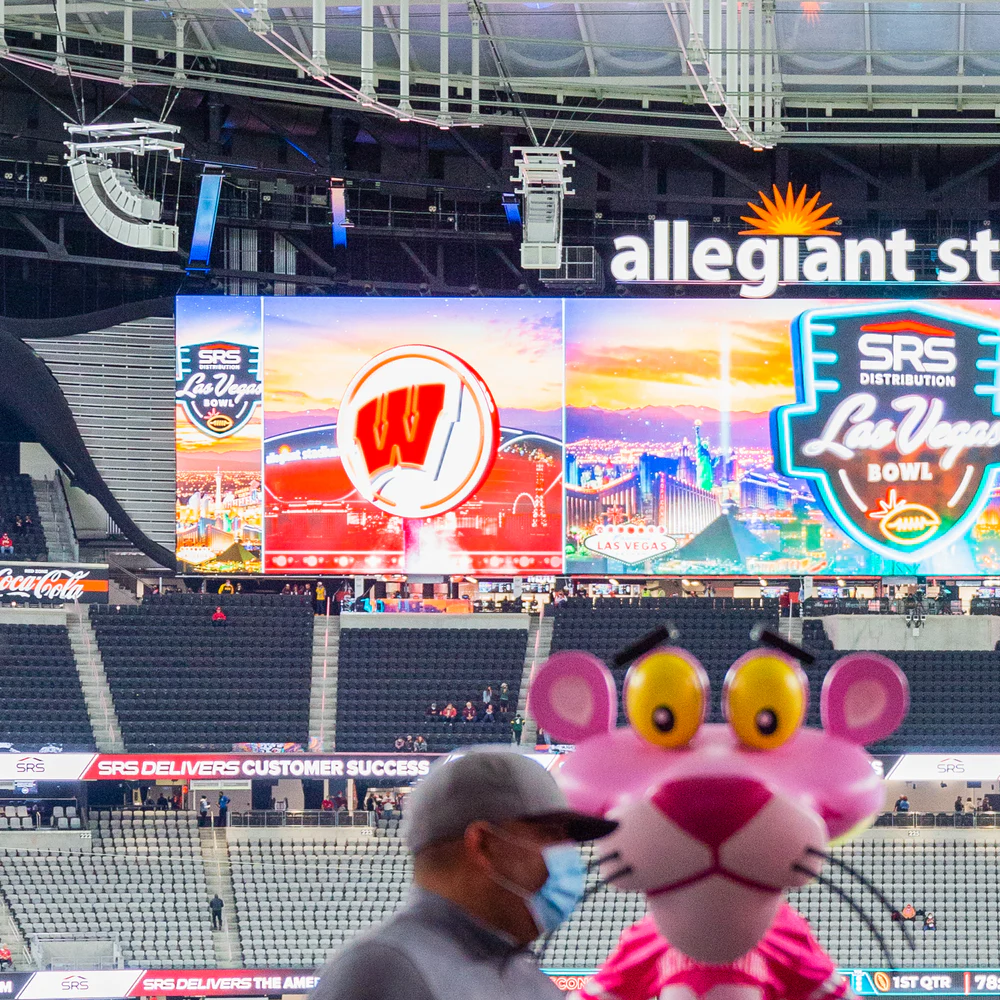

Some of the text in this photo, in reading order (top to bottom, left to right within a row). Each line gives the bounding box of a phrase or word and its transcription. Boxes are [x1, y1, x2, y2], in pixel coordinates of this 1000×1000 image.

[610, 219, 916, 299] allegiant
[198, 349, 242, 365] SRS
[858, 332, 958, 374] SRS
[175, 371, 215, 399] Las
[859, 372, 957, 388] DISTRIBUTION
[203, 398, 235, 408] BOWL
[802, 391, 897, 461] Las
[867, 461, 933, 482] BOWL
[597, 541, 668, 551] LAS VEGAS
[16, 762, 46, 773] SRS
[97, 759, 430, 777] SRS DELIVERS CUSTOMER SUCCESS
[936, 763, 966, 774] SRS
[61, 981, 89, 991] SRS
[142, 978, 176, 991] SRS
[175, 977, 253, 991] DELIVERS
[252, 976, 282, 990] THE
[892, 975, 952, 989] 1ST QTR
